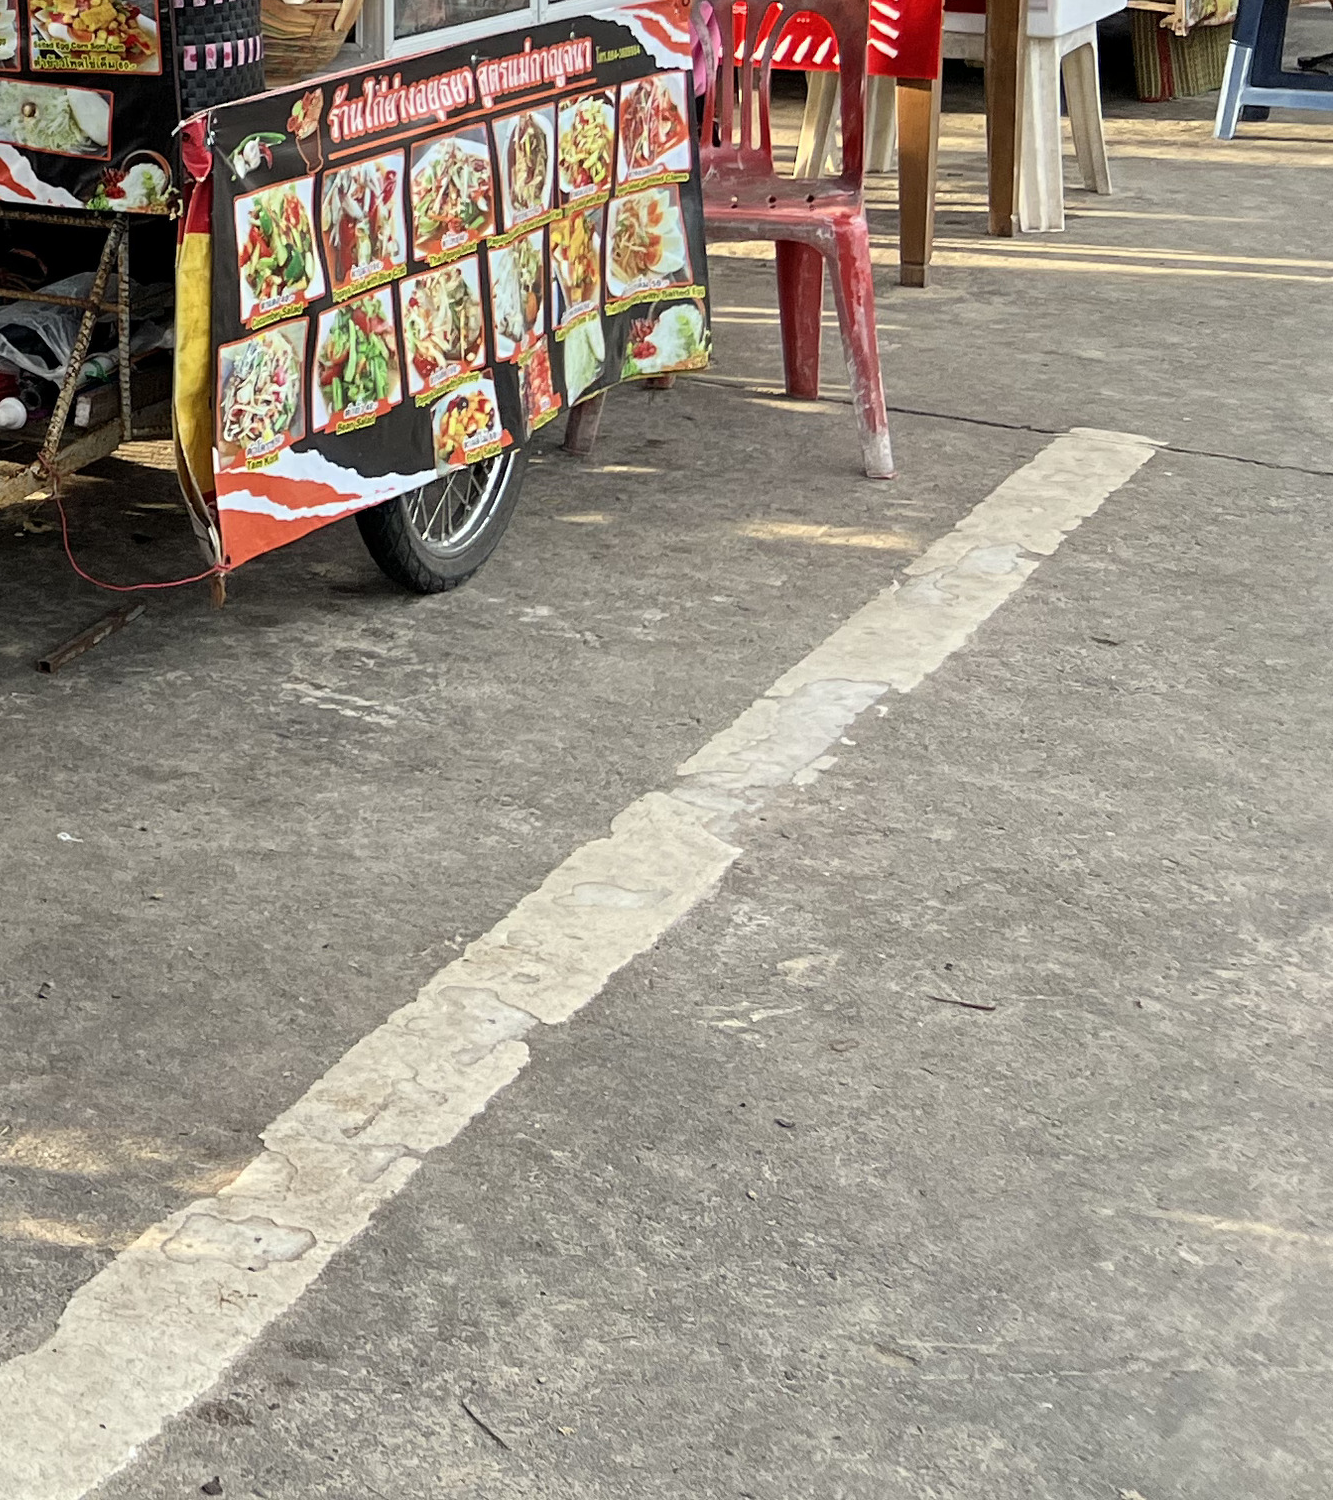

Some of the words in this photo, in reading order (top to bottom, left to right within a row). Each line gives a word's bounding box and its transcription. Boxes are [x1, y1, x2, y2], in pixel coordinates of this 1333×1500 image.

[55, 42, 70, 51] Egg
[71, 42, 89, 50] Corn
[328, 67, 476, 143] ร้านไก่ย่างอยุธยา
[476, 36, 593, 108] สูตรแม่กาญจนา
[282, 303, 303, 317] Salad
[356, 414, 376, 429] Salad
